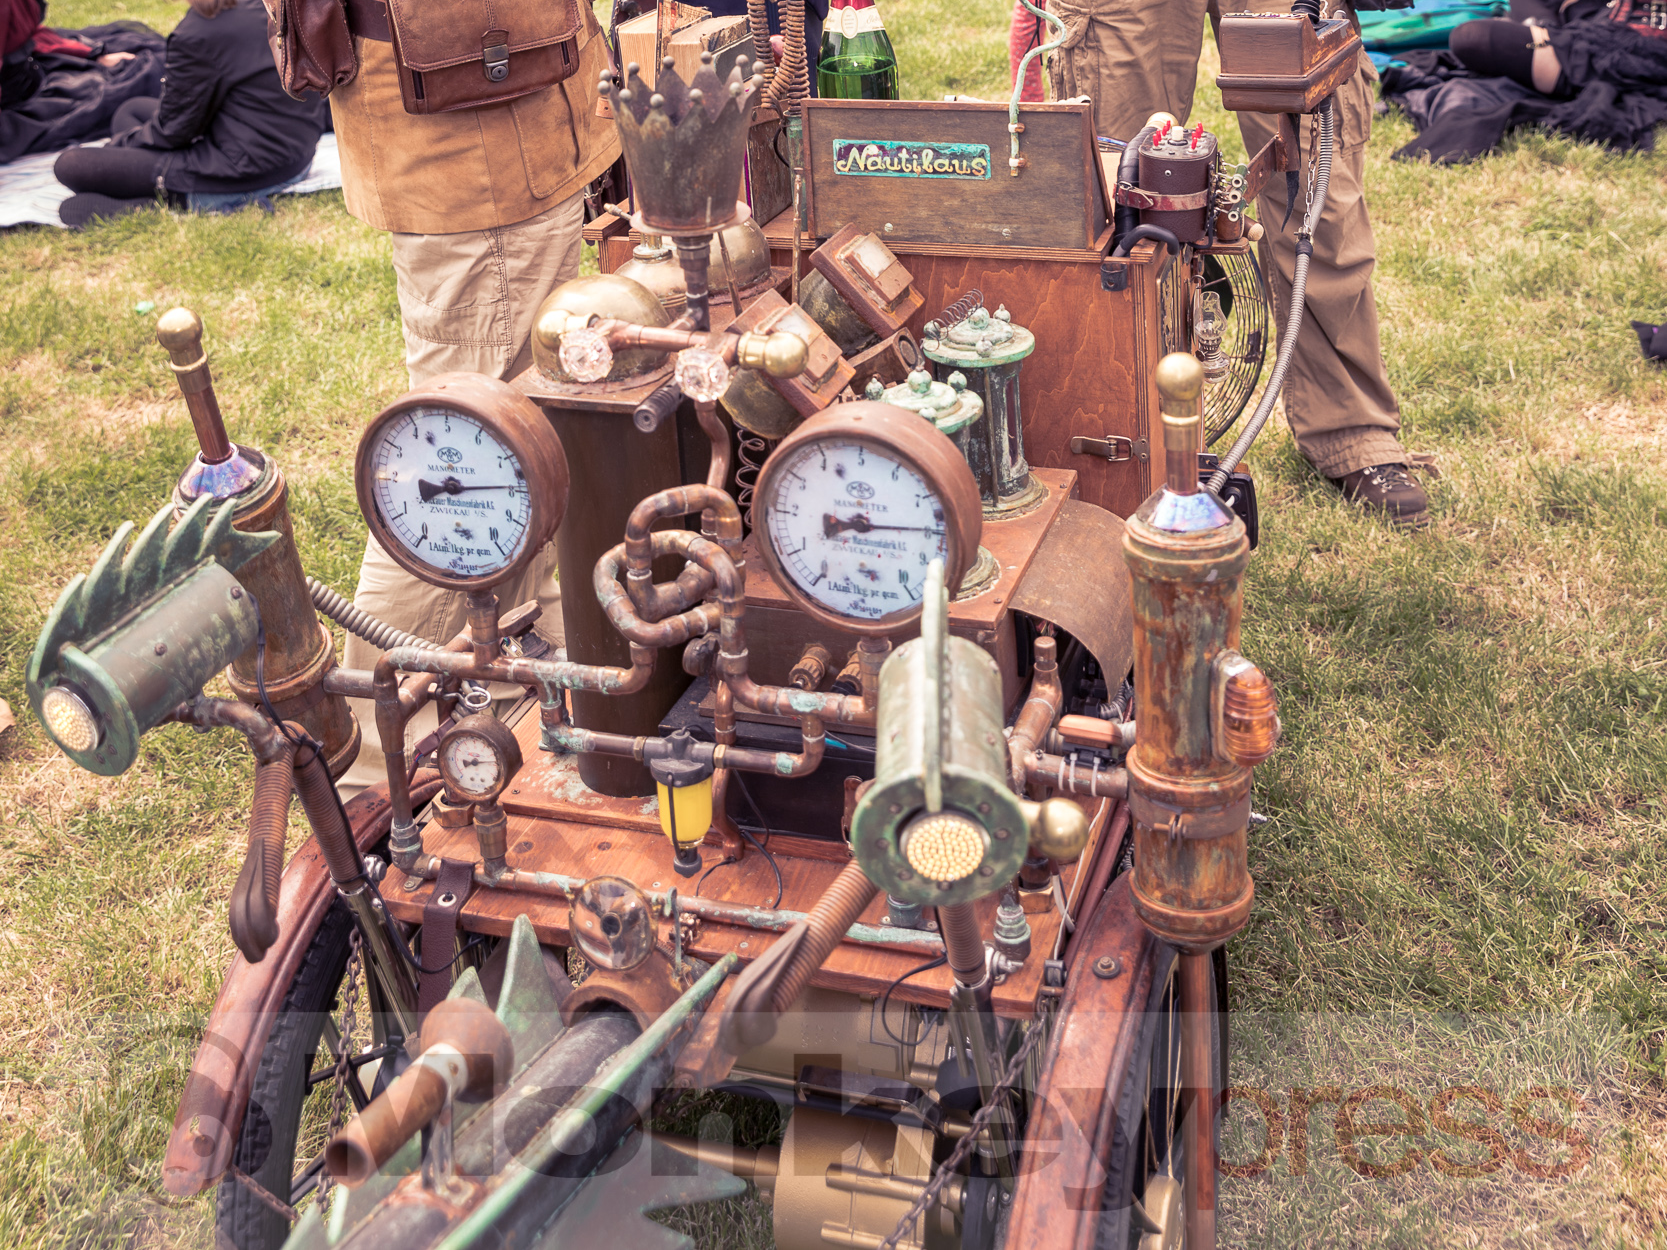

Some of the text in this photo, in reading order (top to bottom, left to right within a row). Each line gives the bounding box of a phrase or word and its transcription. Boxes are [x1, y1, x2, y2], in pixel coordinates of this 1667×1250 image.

[413, 427, 419, 439] 4
[445, 421, 451, 433] 5
[475, 433, 482, 445] 6
[397, 446, 403, 458] 3
[497, 456, 502, 468] 7
[820, 457, 827, 471] 4
[858, 452, 865, 466] 5
[392, 471, 398, 483] 2
[891, 468, 899, 481] 6
[799, 478, 806, 490] 3
[508, 485, 515, 497] 8
[915, 494, 920, 508] 7
[430, 506, 471, 516] ZWICKAU
[506, 509, 513, 522] 9
[792, 503, 799, 517] 2
[421, 522, 428, 535] 0
[489, 527, 499, 541] 10
[919, 552, 926, 565] 9
[820, 559, 828, 574] 0
[898, 569, 909, 584] 10
